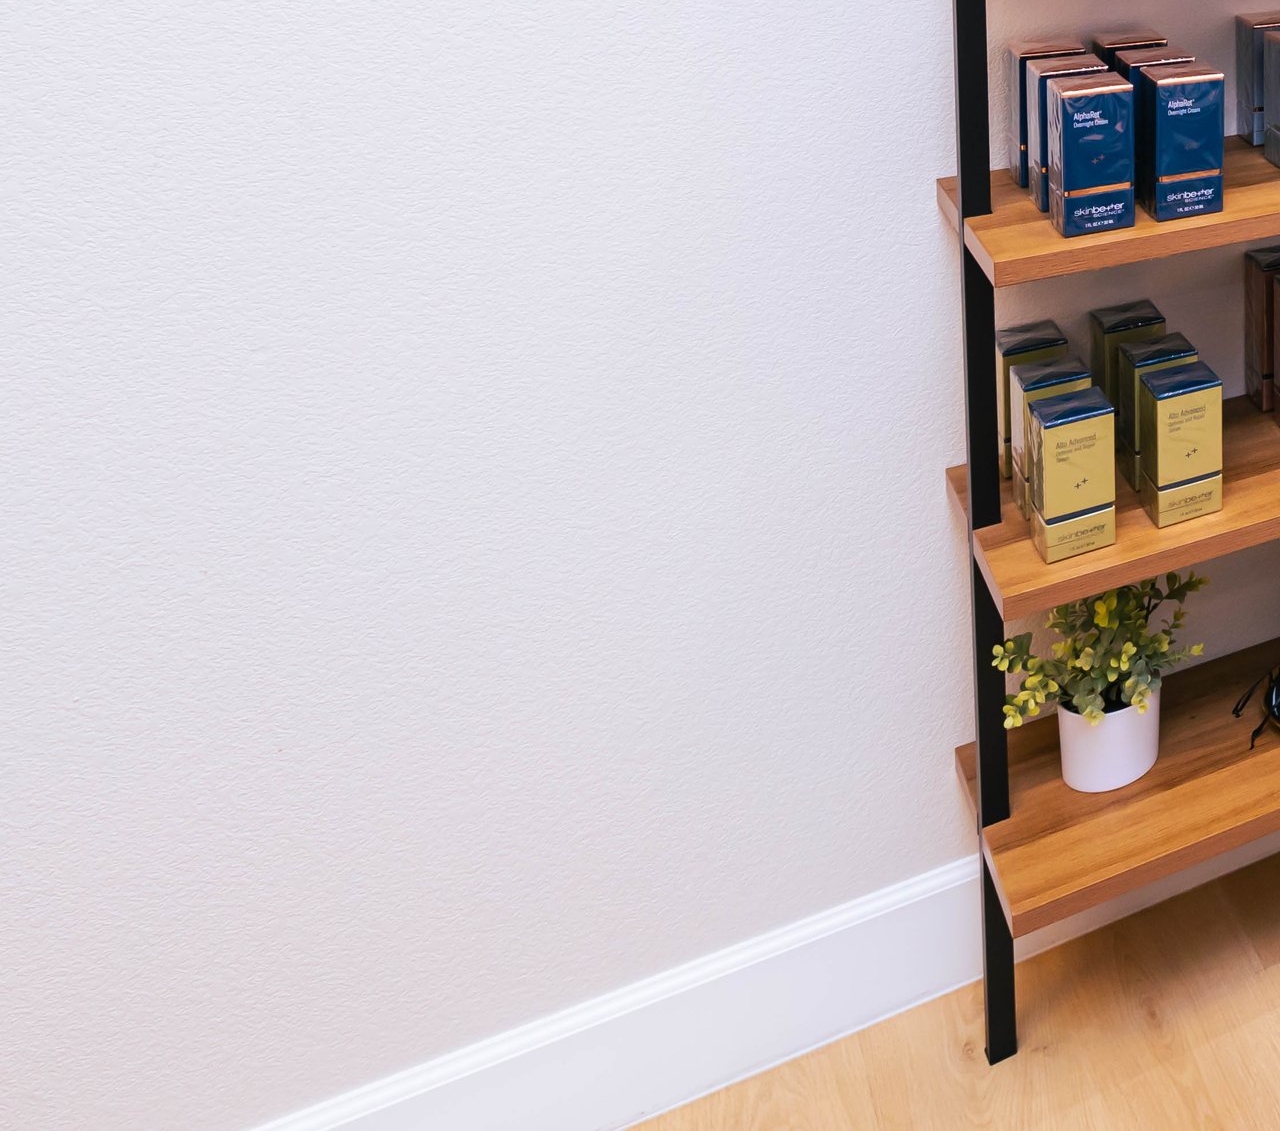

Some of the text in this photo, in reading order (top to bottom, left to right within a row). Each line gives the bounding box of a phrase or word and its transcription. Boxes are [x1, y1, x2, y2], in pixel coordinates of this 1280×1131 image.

[1168, 99, 1194, 109] AlphaRet
[1073, 111, 1100, 121] AlphaRet
[1168, 108, 1187, 116] Overnight
[1167, 189, 1214, 202] skinbetter
[1074, 202, 1125, 217] skinbetter
